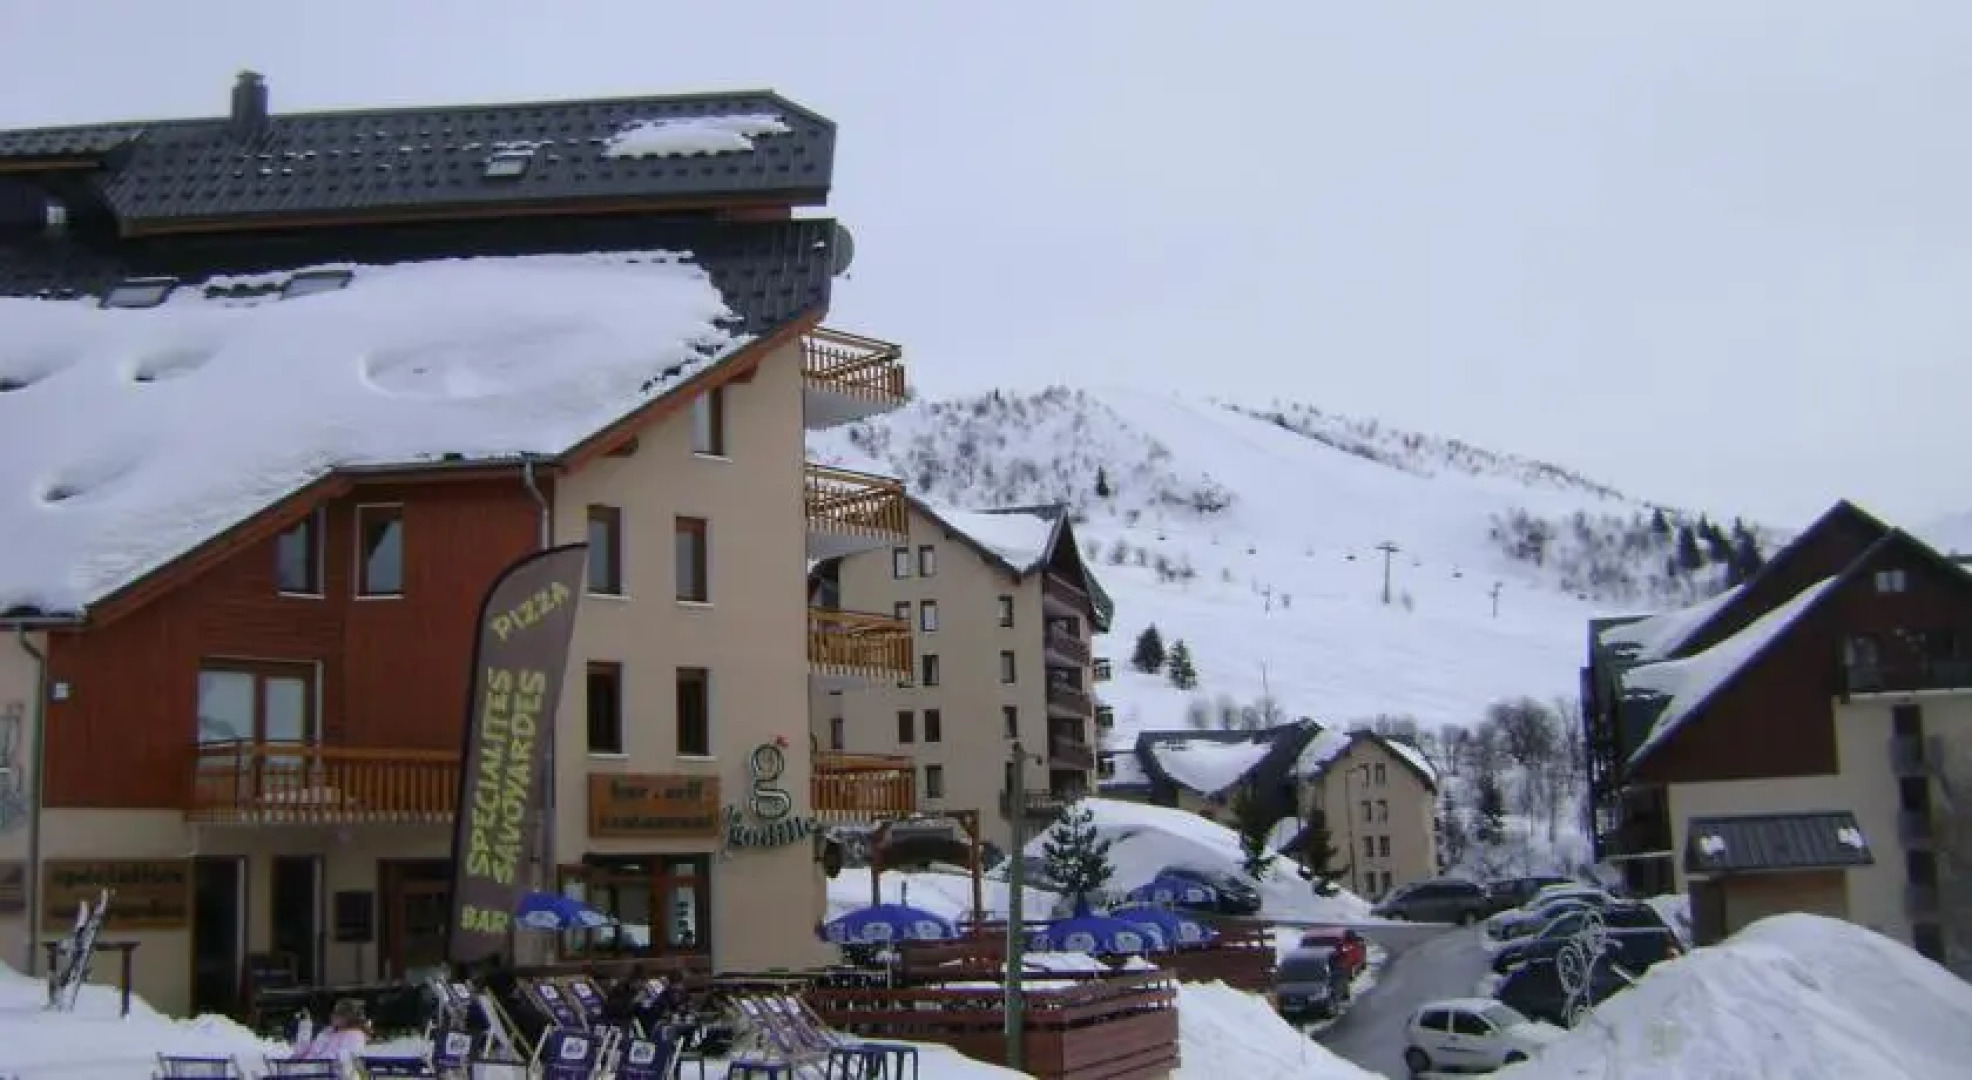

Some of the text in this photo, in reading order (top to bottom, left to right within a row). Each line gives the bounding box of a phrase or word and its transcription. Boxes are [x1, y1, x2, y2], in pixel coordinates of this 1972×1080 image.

[490, 581, 570, 641] PIZZA
[466, 666, 512, 876] SPECIALITES
[492, 669, 546, 885] SAVOYARDES
[460, 906, 508, 933] BAR
